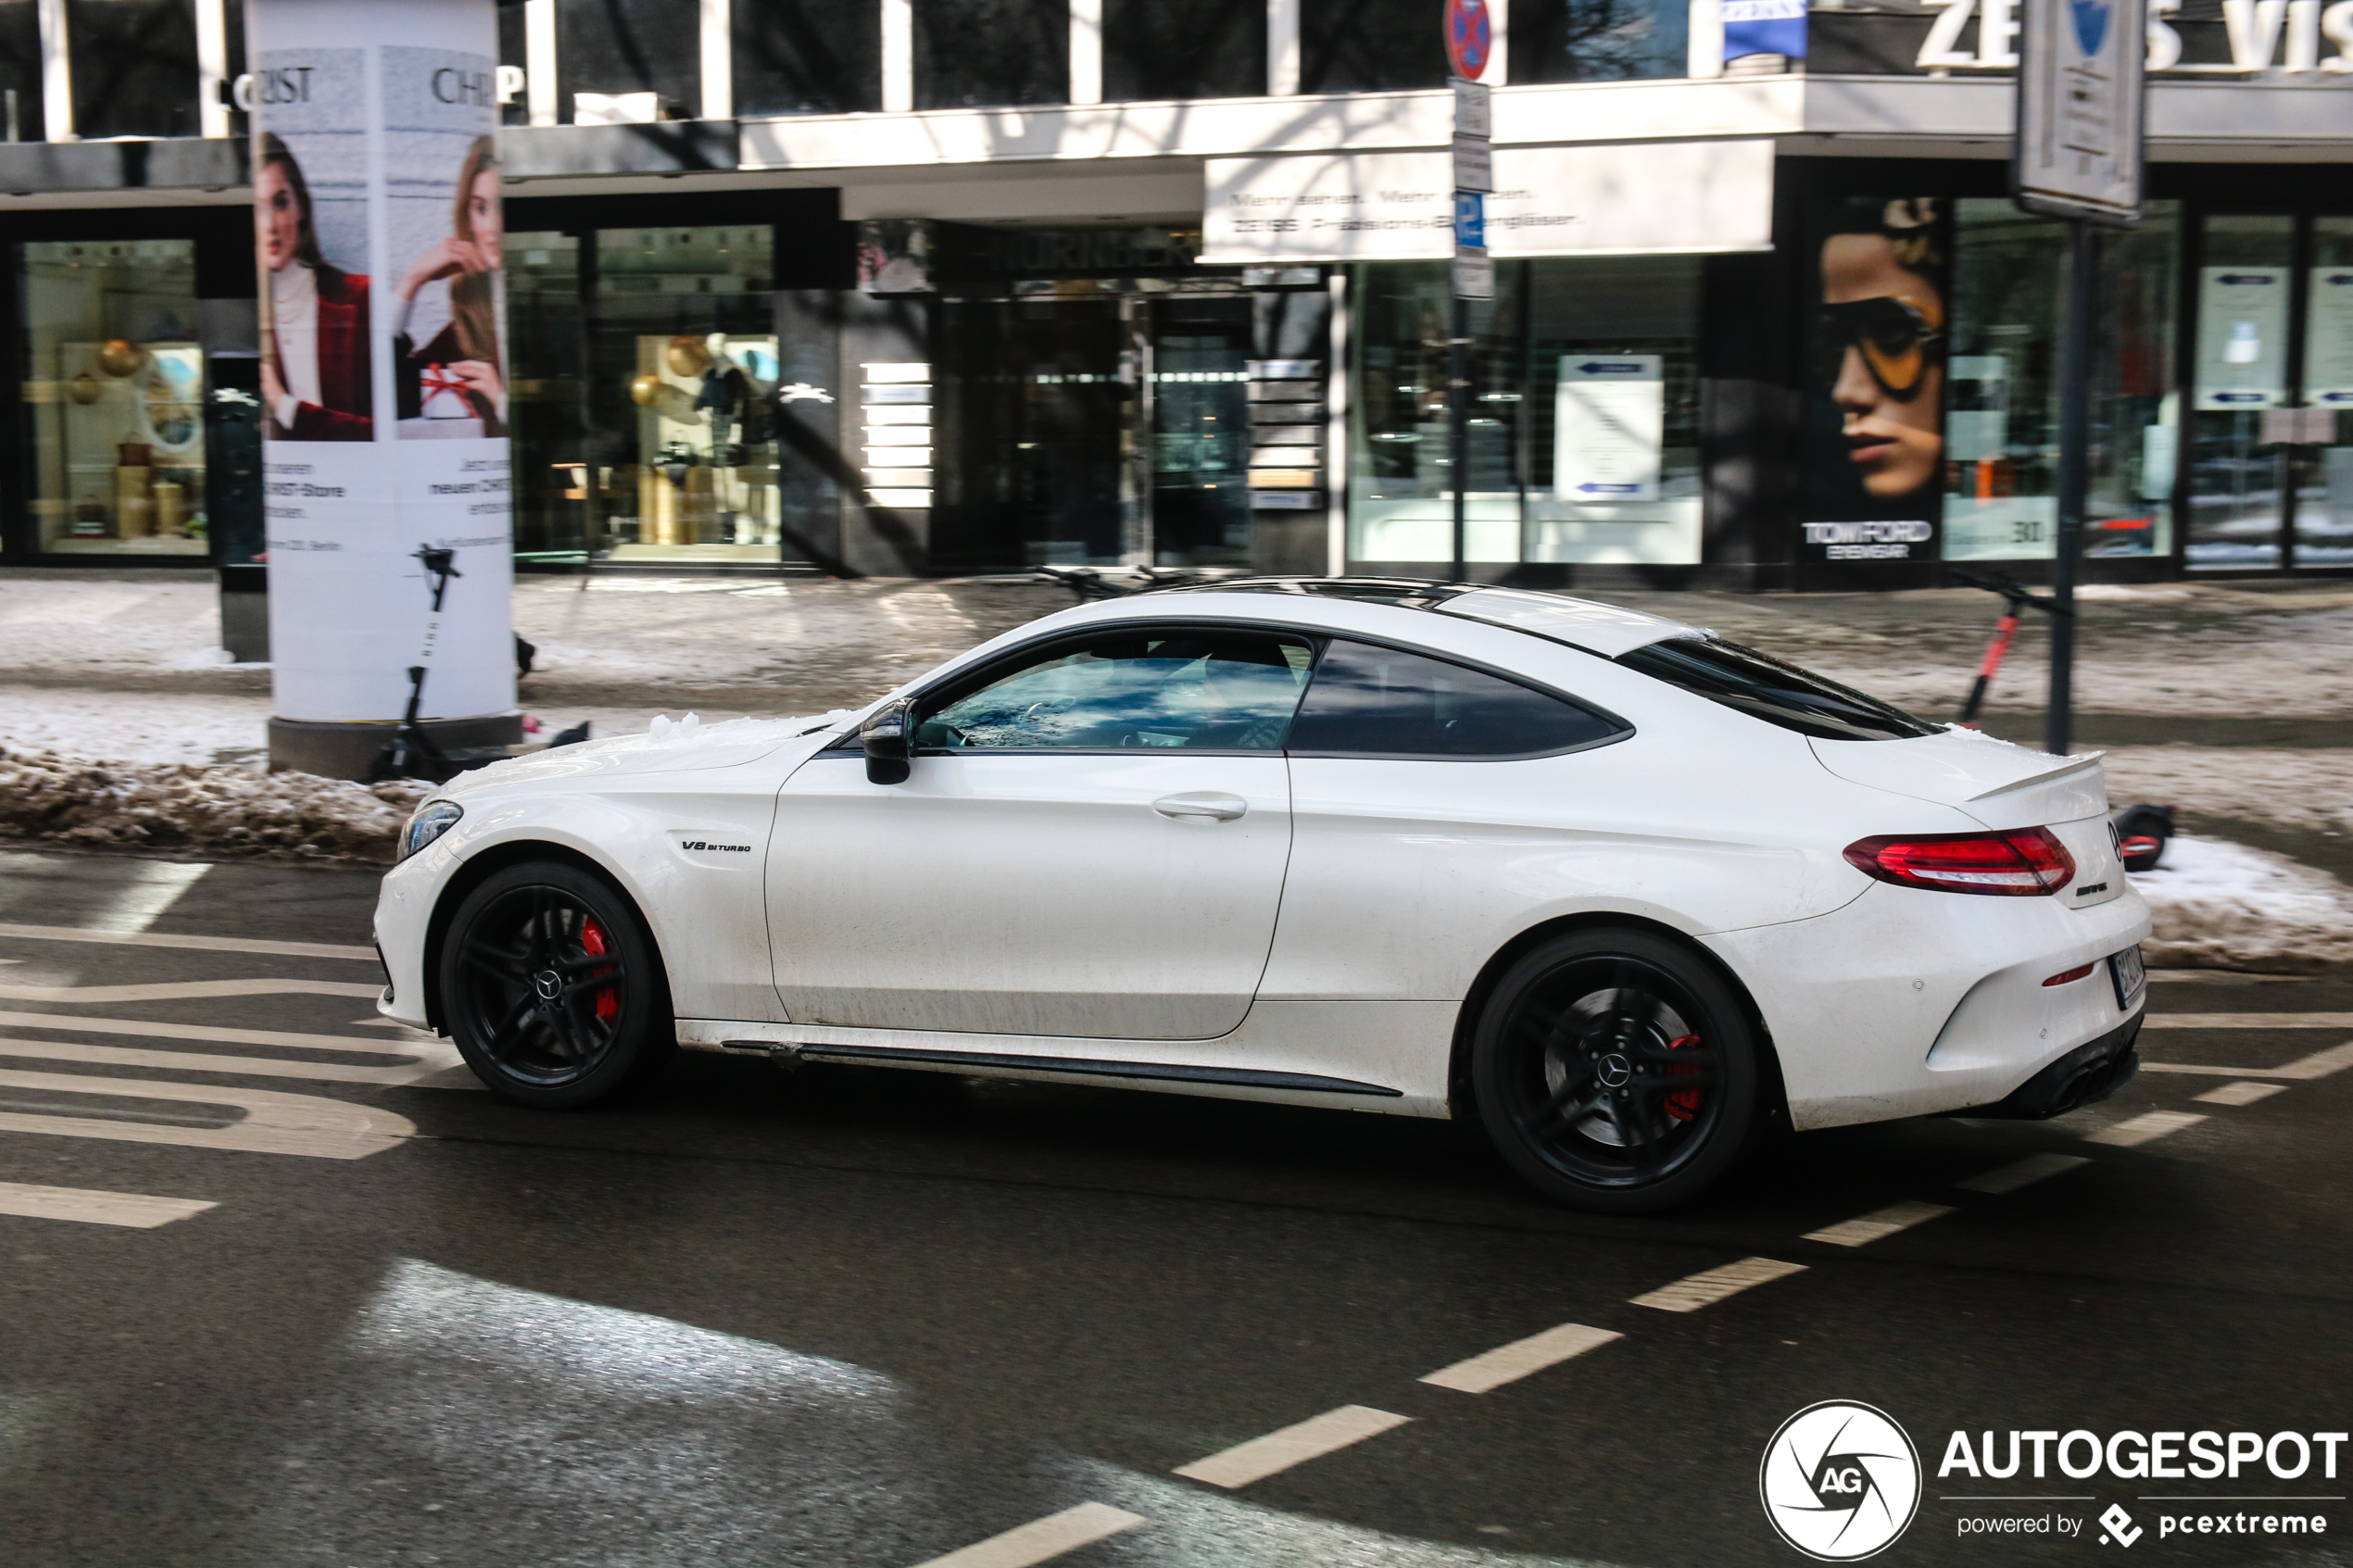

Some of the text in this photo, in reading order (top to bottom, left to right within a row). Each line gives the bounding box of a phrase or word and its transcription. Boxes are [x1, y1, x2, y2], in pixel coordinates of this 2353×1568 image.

[1802, 521, 1861, 544] TOM
[1861, 520, 1932, 544] FORD
[682, 841, 751, 852] V8 BITURBO
